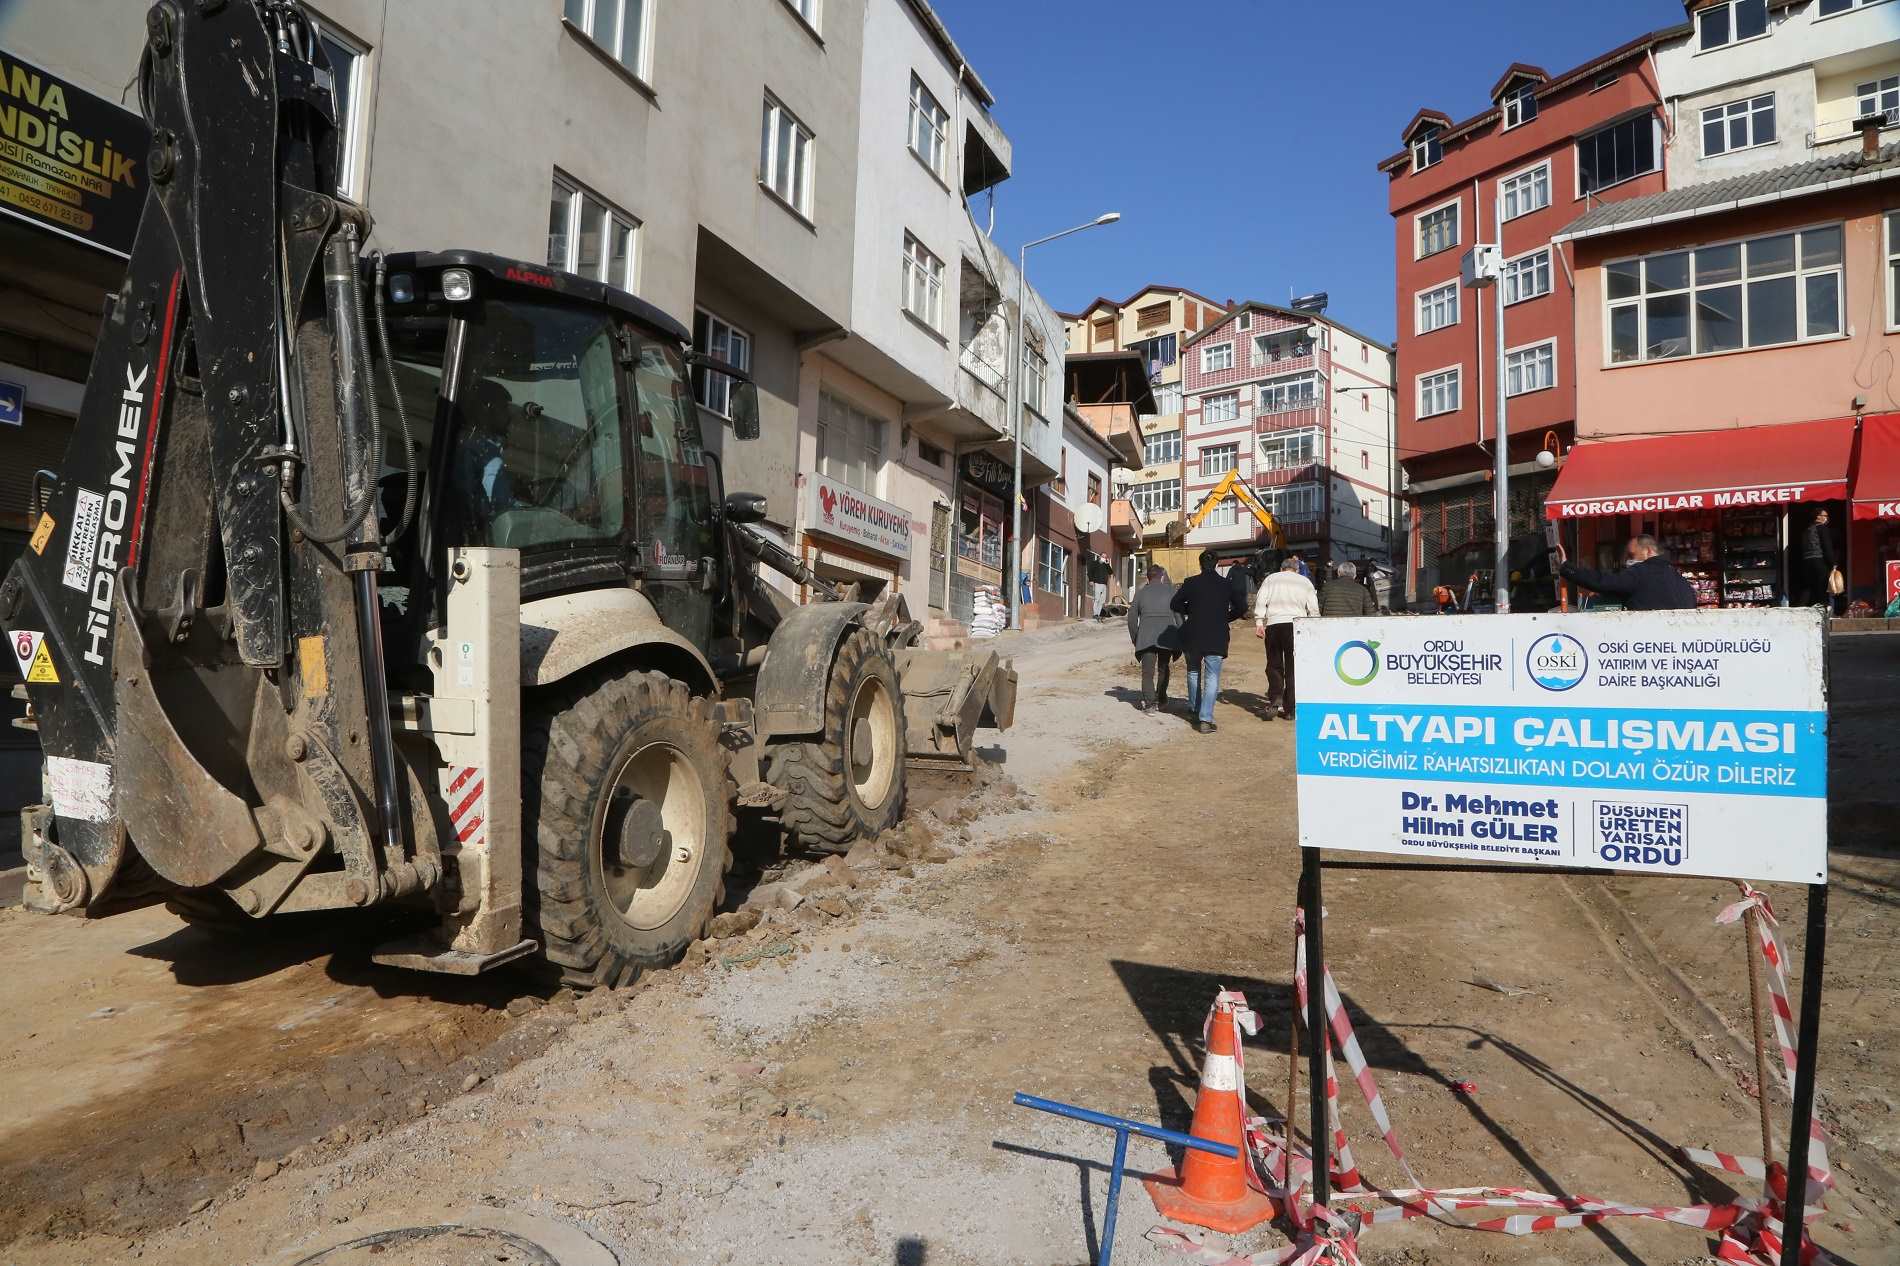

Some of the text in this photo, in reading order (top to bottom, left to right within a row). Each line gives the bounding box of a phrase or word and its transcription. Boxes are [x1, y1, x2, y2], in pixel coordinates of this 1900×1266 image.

[26, 153, 78, 182] Ramazan
[506, 268, 555, 287] ALPHA
[1562, 487, 1805, 517] KORGANCILAR MARKET
[840, 491, 909, 541] YÖREM KURUYEMİŞ
[78, 502, 94, 561] METREDEN
[1423, 640, 1463, 653] ORDU
[1598, 638, 1771, 653] OSKİ GENEL MÜDÜRLÜĞÜ
[1386, 654, 1502, 672] BÜYÜKŞEHİR
[1537, 652, 1577, 668] OSKİ
[1598, 657, 1719, 673] YATIRIM VE İNŞAAT
[1598, 673, 1721, 690] DAİRE BAŞKANLIĞI
[1318, 713, 1796, 755] ALTYAPI ÇALIŞMASI
[1318, 748, 1797, 786] VERDİĞİMİZ RAHATSIZLIKTAN DOLAYI ÖZÜR DİLERİZ
[1401, 791, 1559, 819] Dr. Mehmet
[1402, 816, 1558, 843] Hilmi GÜLER
[1600, 817, 1681, 834] ÜRETEN
[1401, 839, 1561, 856] ORDU BÜYÜKŞEHİR BELEDİYE BAŞKANI
[1600, 844, 1681, 866] ORDU
